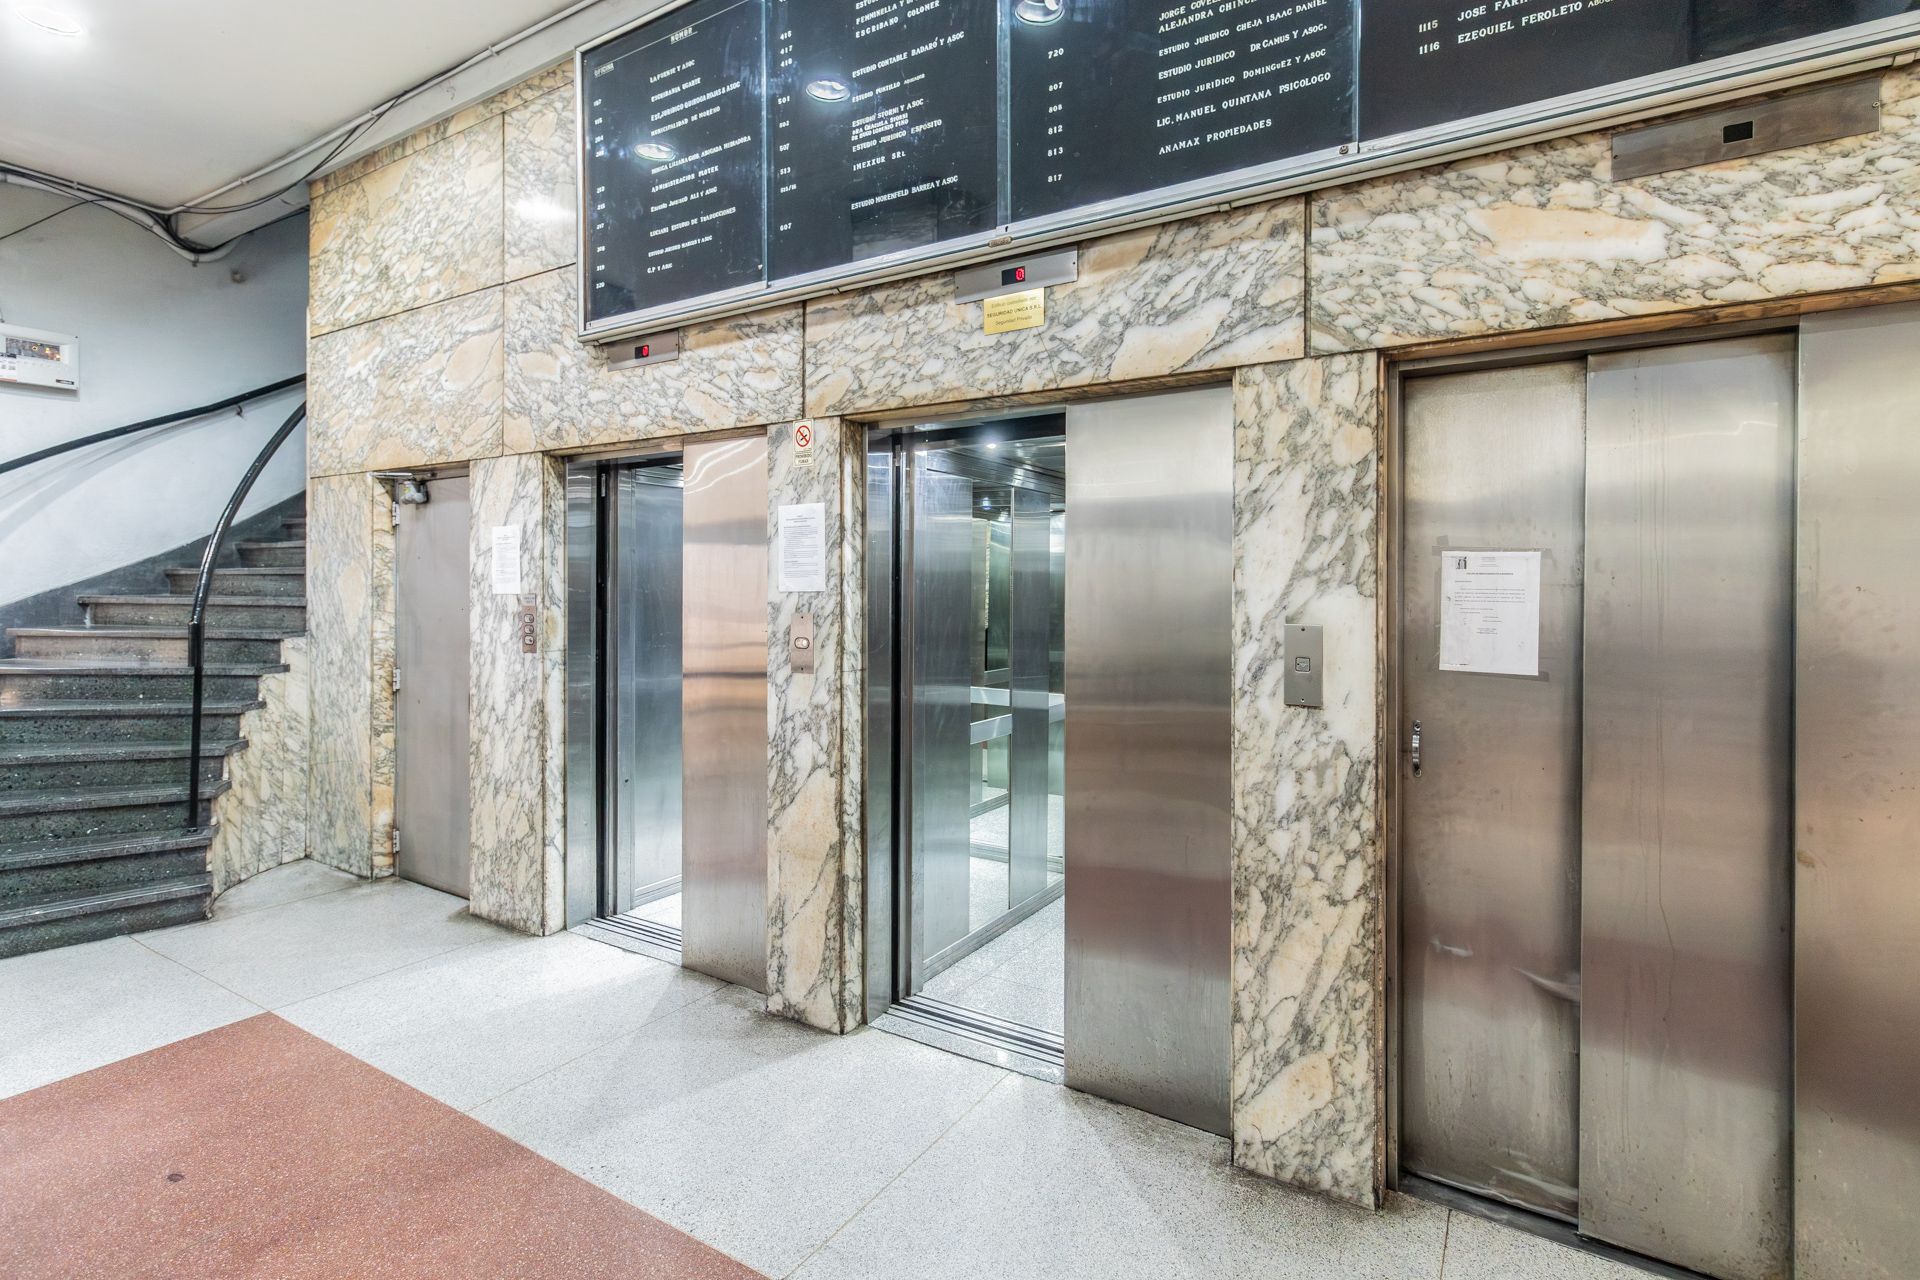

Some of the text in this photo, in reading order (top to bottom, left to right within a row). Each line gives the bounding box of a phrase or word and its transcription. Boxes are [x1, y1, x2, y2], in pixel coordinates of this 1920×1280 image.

[1159, 6, 1185, 21] JORGE
[1457, 5, 1487, 21] JOSE
[856, 16, 898, 38] ESCRIBANO
[1159, 9, 1213, 33] ALEJANDRA
[1159, 0, 1327, 57] ESTUDIO JURIDICO CHEJA ISAAC DANIEL
[1419, 20, 1438, 33] 1115
[1457, 20, 1515, 43] EZEQUIEL
[1521, 2, 1582, 26] FEROLETO
[780, 45, 793, 55] 417
[852, 64, 877, 78] ESTUDIO
[878, 52, 908, 69] CONTABLE
[939, 38, 944, 46] Y
[947, 31, 965, 44] ASOC
[1048, 48, 1064, 59] 720
[1159, 64, 1191, 80] ESTUDIO
[1195, 50, 1235, 68] JURIDICO
[1292, 31, 1298, 39] Y
[1302, 23, 1327, 37] ASOC.
[1419, 41, 1440, 55] 1116
[1157, 89, 1190, 103] ESTUDIO
[1194, 76, 1235, 95] JURIDICO
[1303, 49, 1326, 62] ASOC
[726, 81, 741, 92] ASOC
[1048, 82, 1063, 92] 807
[1222, 90, 1271, 110] QUINTANA
[1279, 72, 1331, 95] PSICOLOGO
[877, 107, 899, 118] STORNI
[907, 99, 924, 109] ASOC
[1048, 104, 1063, 114] 808
[1048, 125, 1063, 135] 812
[1159, 118, 1272, 156] ANAMAX PROPIEDADES
[852, 140, 877, 152] ESTUDIO
[1048, 147, 1064, 157] 813
[892, 151, 906, 160] SRL
[1048, 174, 1063, 183] 817
[851, 198, 874, 210] ESTUDIO
[875, 189, 909, 203] MORENFELD
[911, 183, 935, 194] BARREA
[942, 175, 958, 186] ASOC
